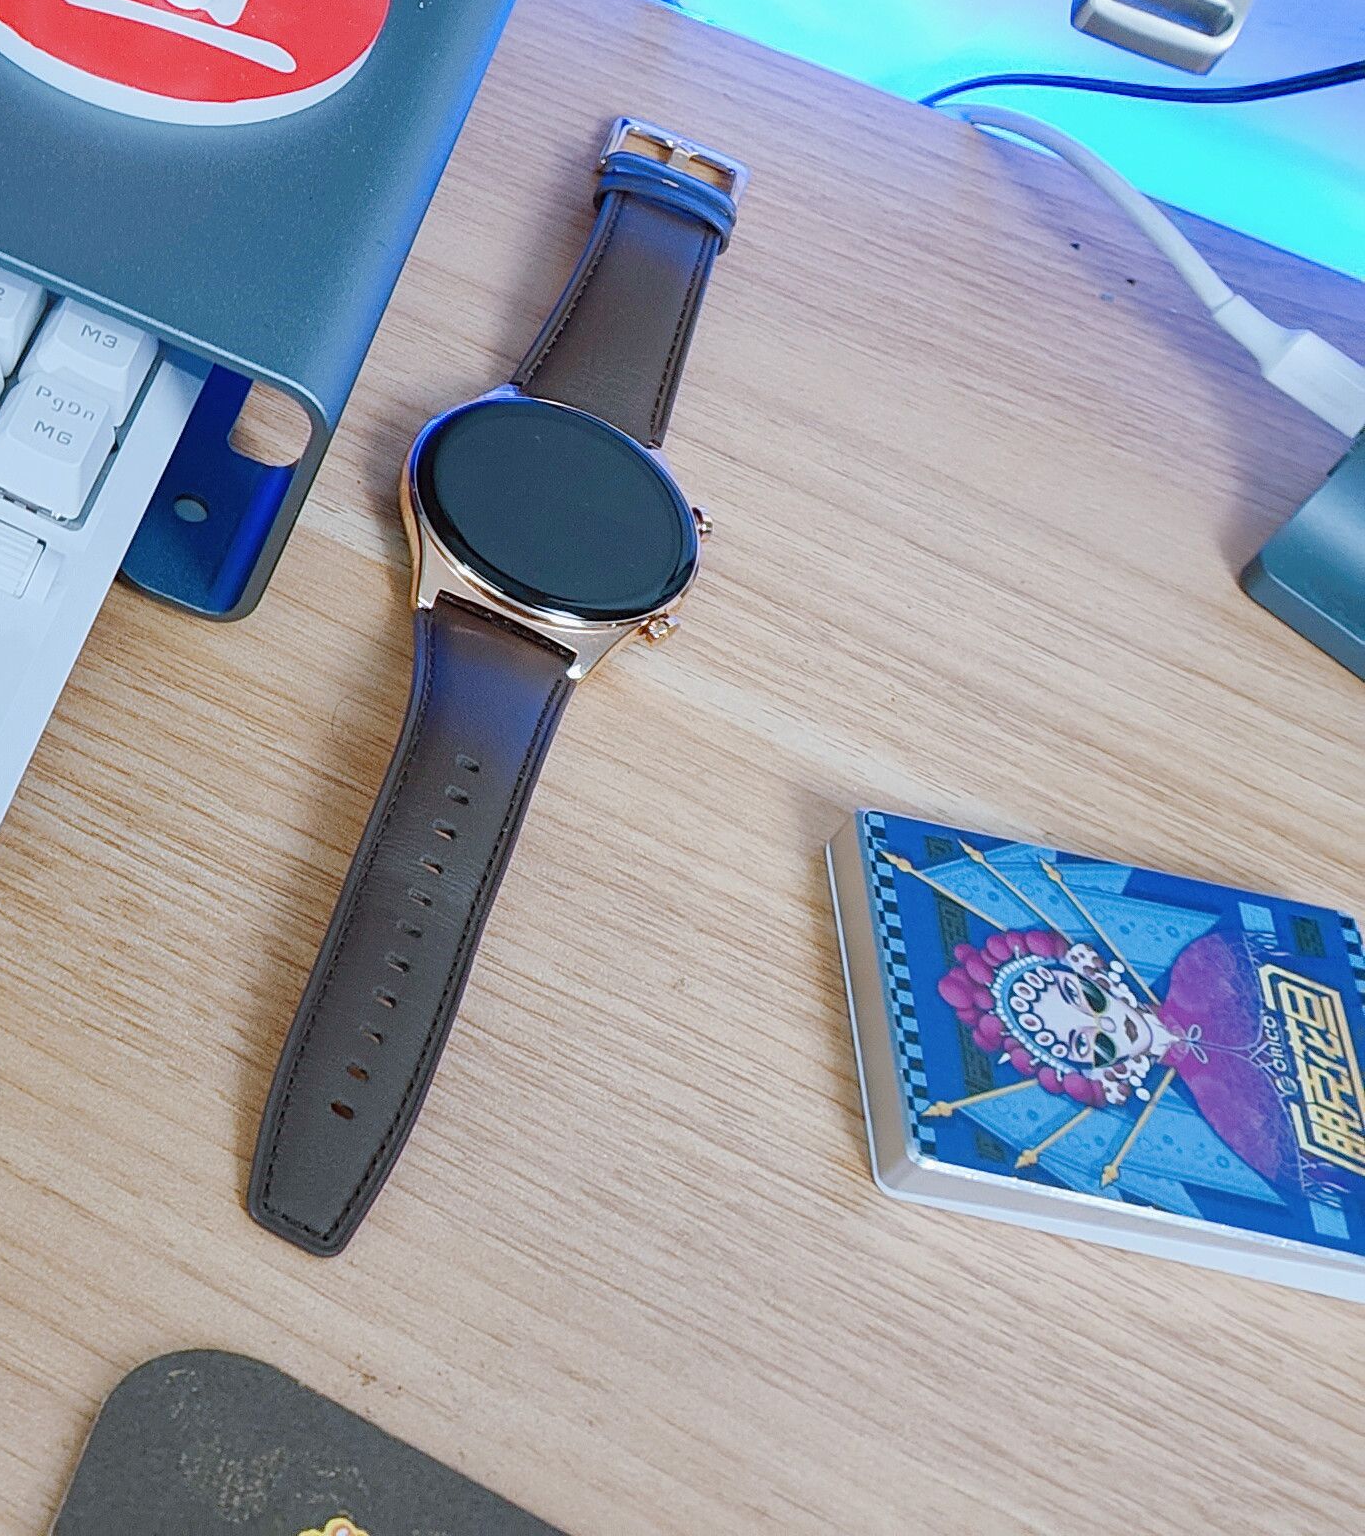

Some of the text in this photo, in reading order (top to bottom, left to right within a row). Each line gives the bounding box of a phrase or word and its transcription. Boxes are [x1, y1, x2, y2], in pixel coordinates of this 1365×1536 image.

[80, 323, 118, 349] M3
[33, 420, 72, 445] M6
[1263, 1014, 1287, 1073] ORICO
